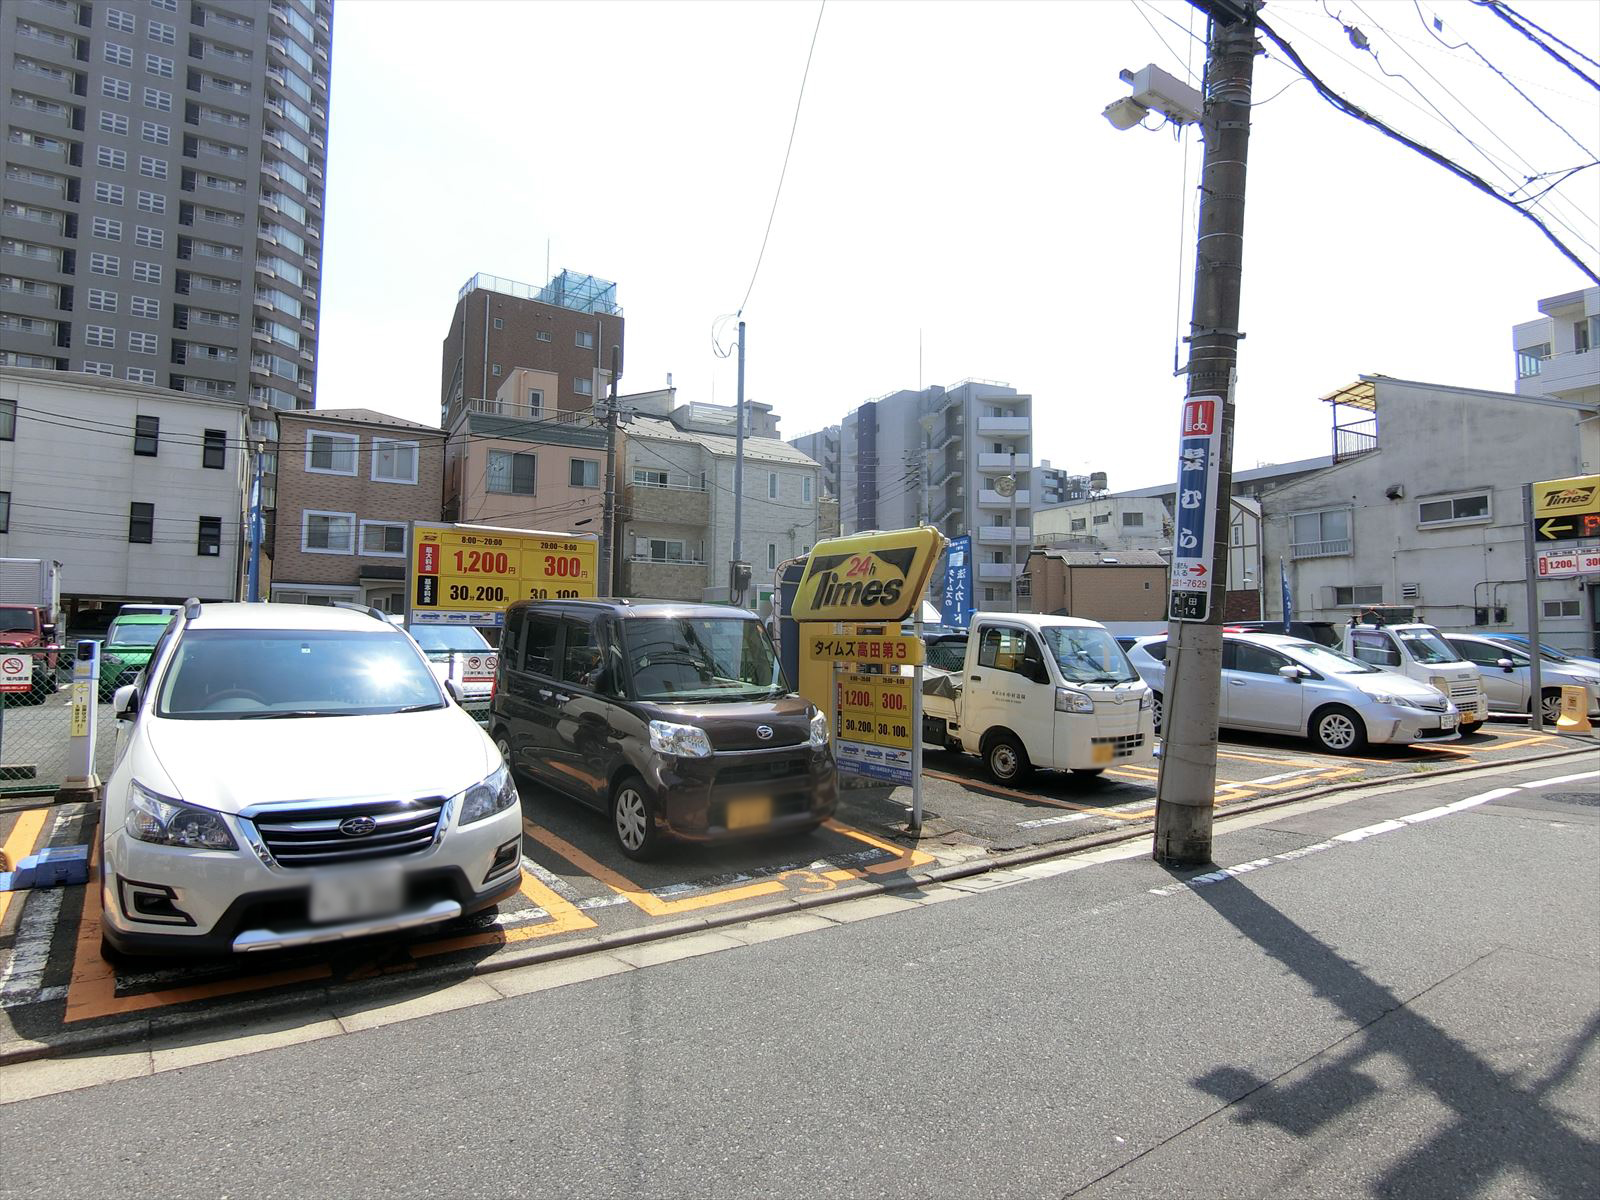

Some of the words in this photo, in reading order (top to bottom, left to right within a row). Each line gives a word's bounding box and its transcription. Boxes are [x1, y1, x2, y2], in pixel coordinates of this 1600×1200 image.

[1545, 494, 1590, 507] Times
[1586, 557, 1600, 567] 30
[810, 571, 904, 610] Times
